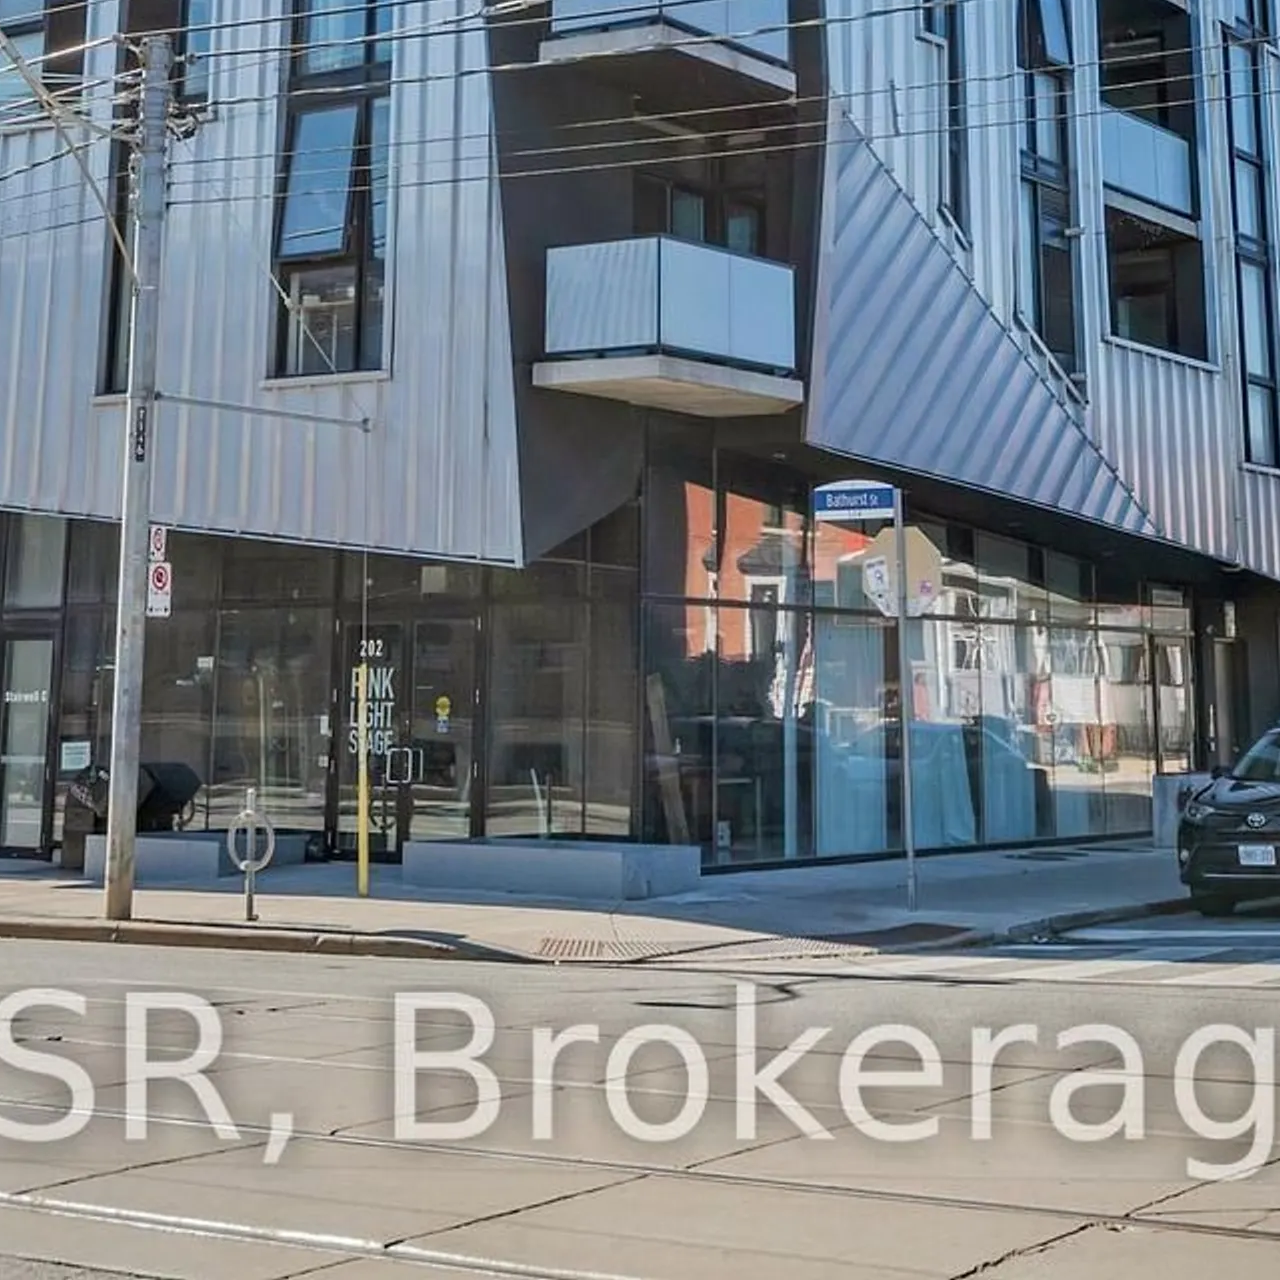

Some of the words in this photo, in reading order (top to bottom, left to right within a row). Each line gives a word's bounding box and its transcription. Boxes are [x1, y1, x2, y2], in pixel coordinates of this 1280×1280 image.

[825, 493, 868, 508] Bathurst
[870, 494, 879, 506] St
[360, 639, 384, 657] 202
[350, 666, 395, 699] PNK
[349, 701, 396, 729] LGHT
[347, 729, 395, 755] SAGE
